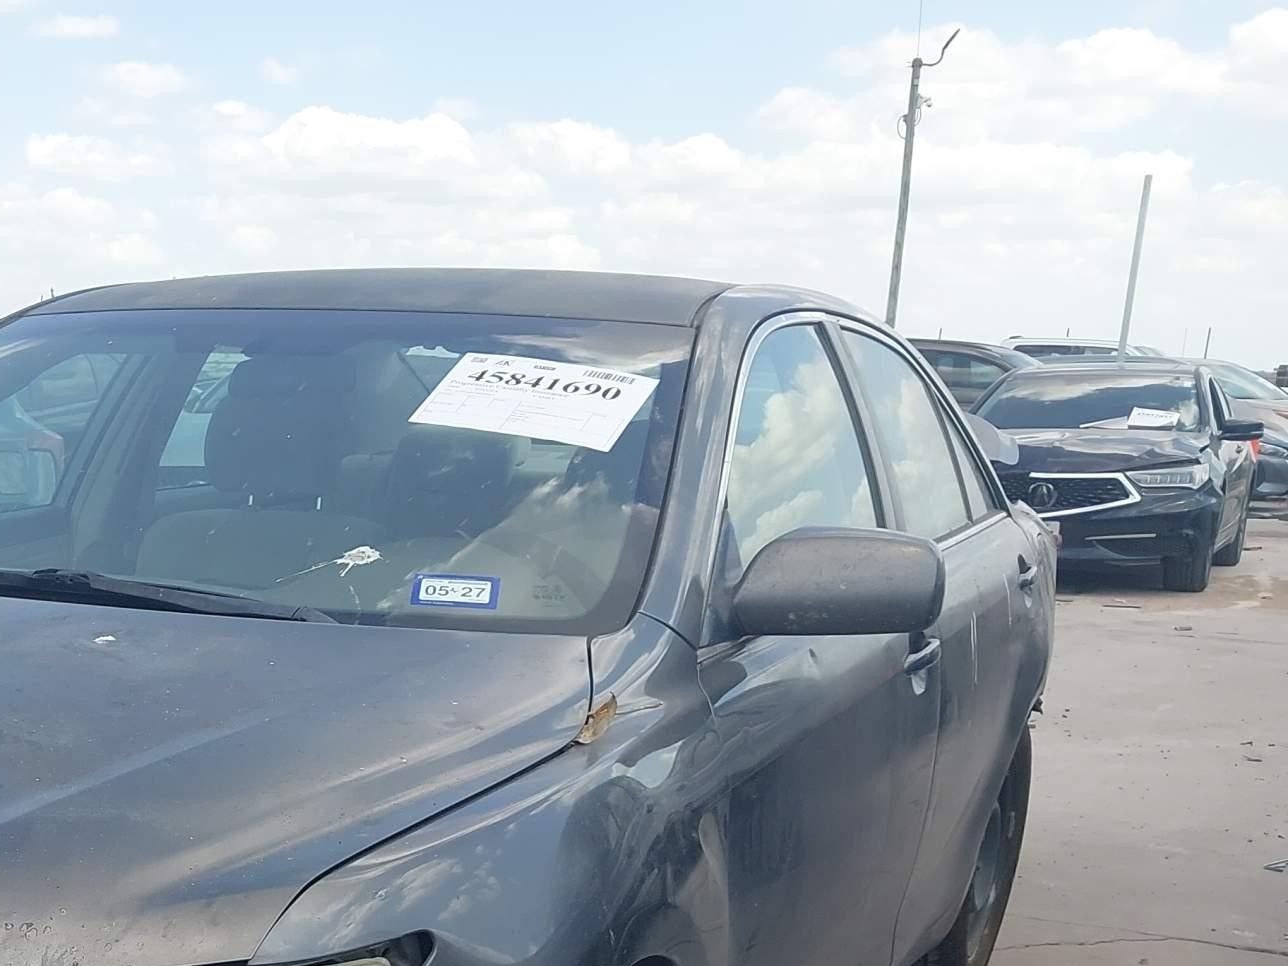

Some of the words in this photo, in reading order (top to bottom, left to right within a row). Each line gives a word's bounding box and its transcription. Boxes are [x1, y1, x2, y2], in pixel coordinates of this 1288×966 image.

[467, 369, 622, 401] 45841690
[425, 585, 449, 597] 05
[461, 586, 486, 598] 27
